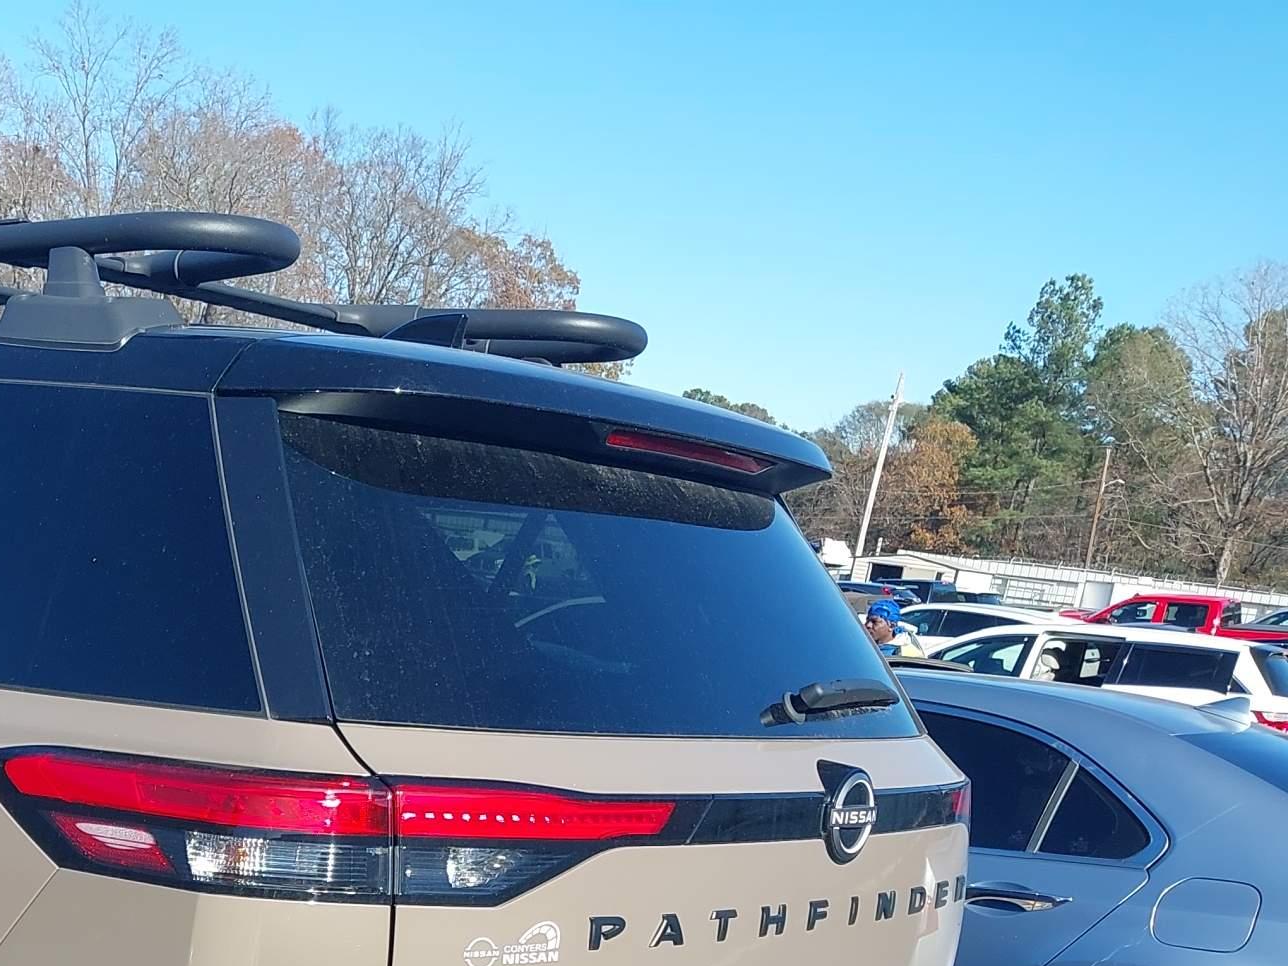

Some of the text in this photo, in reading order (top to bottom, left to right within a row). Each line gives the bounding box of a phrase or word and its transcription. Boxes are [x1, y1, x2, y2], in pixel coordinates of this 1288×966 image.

[831, 810, 877, 825] NISSAN
[587, 874, 966, 951] PATHFINDER
[462, 950, 500, 959] NISSAN
[503, 943, 547, 953] CONYERS
[502, 951, 559, 965] NISSAN
